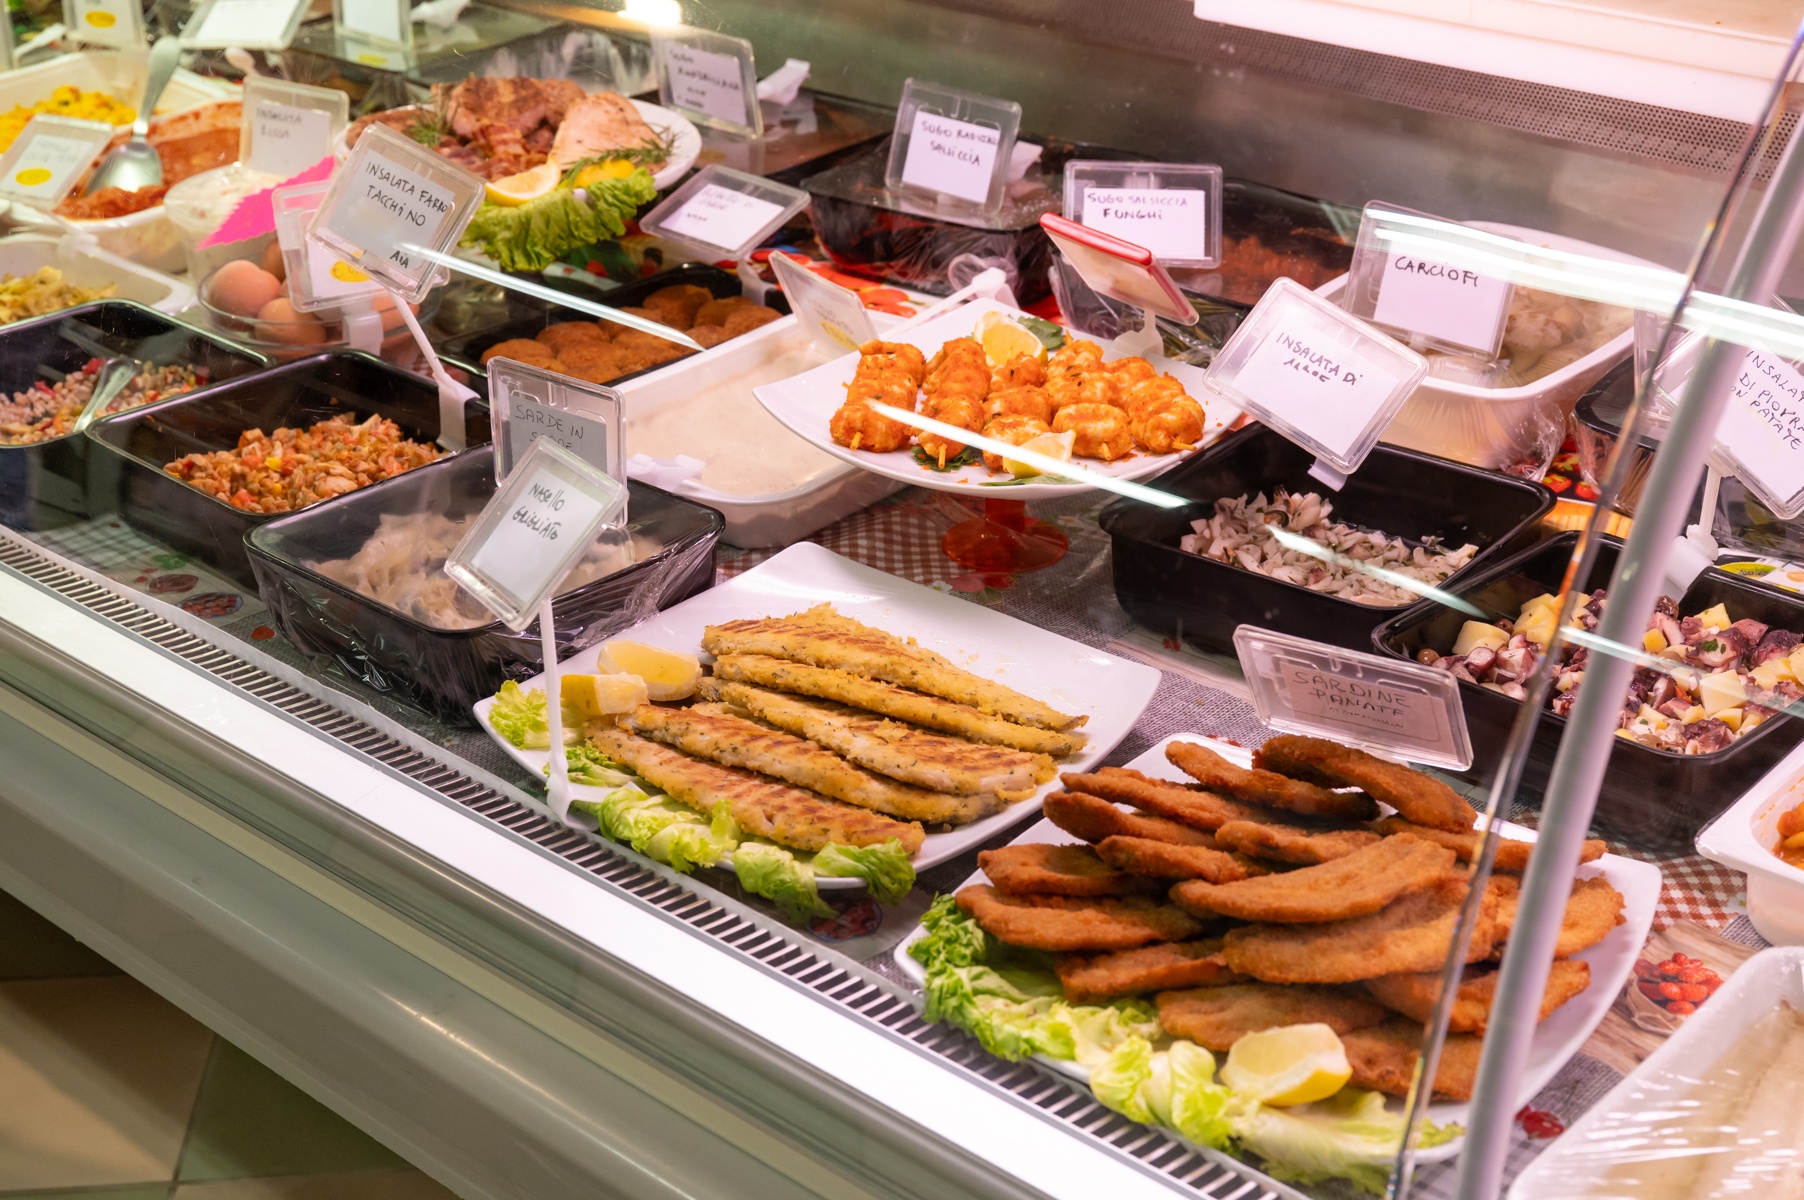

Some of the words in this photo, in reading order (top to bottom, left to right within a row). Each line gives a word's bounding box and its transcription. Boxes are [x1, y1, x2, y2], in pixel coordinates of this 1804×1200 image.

[365, 161, 415, 196] INSALATA
[1087, 193, 1124, 204] SUGO
[1276, 332, 1340, 376] INSALATA
[515, 404, 563, 432] SARDE
[570, 425, 584, 439] IN
